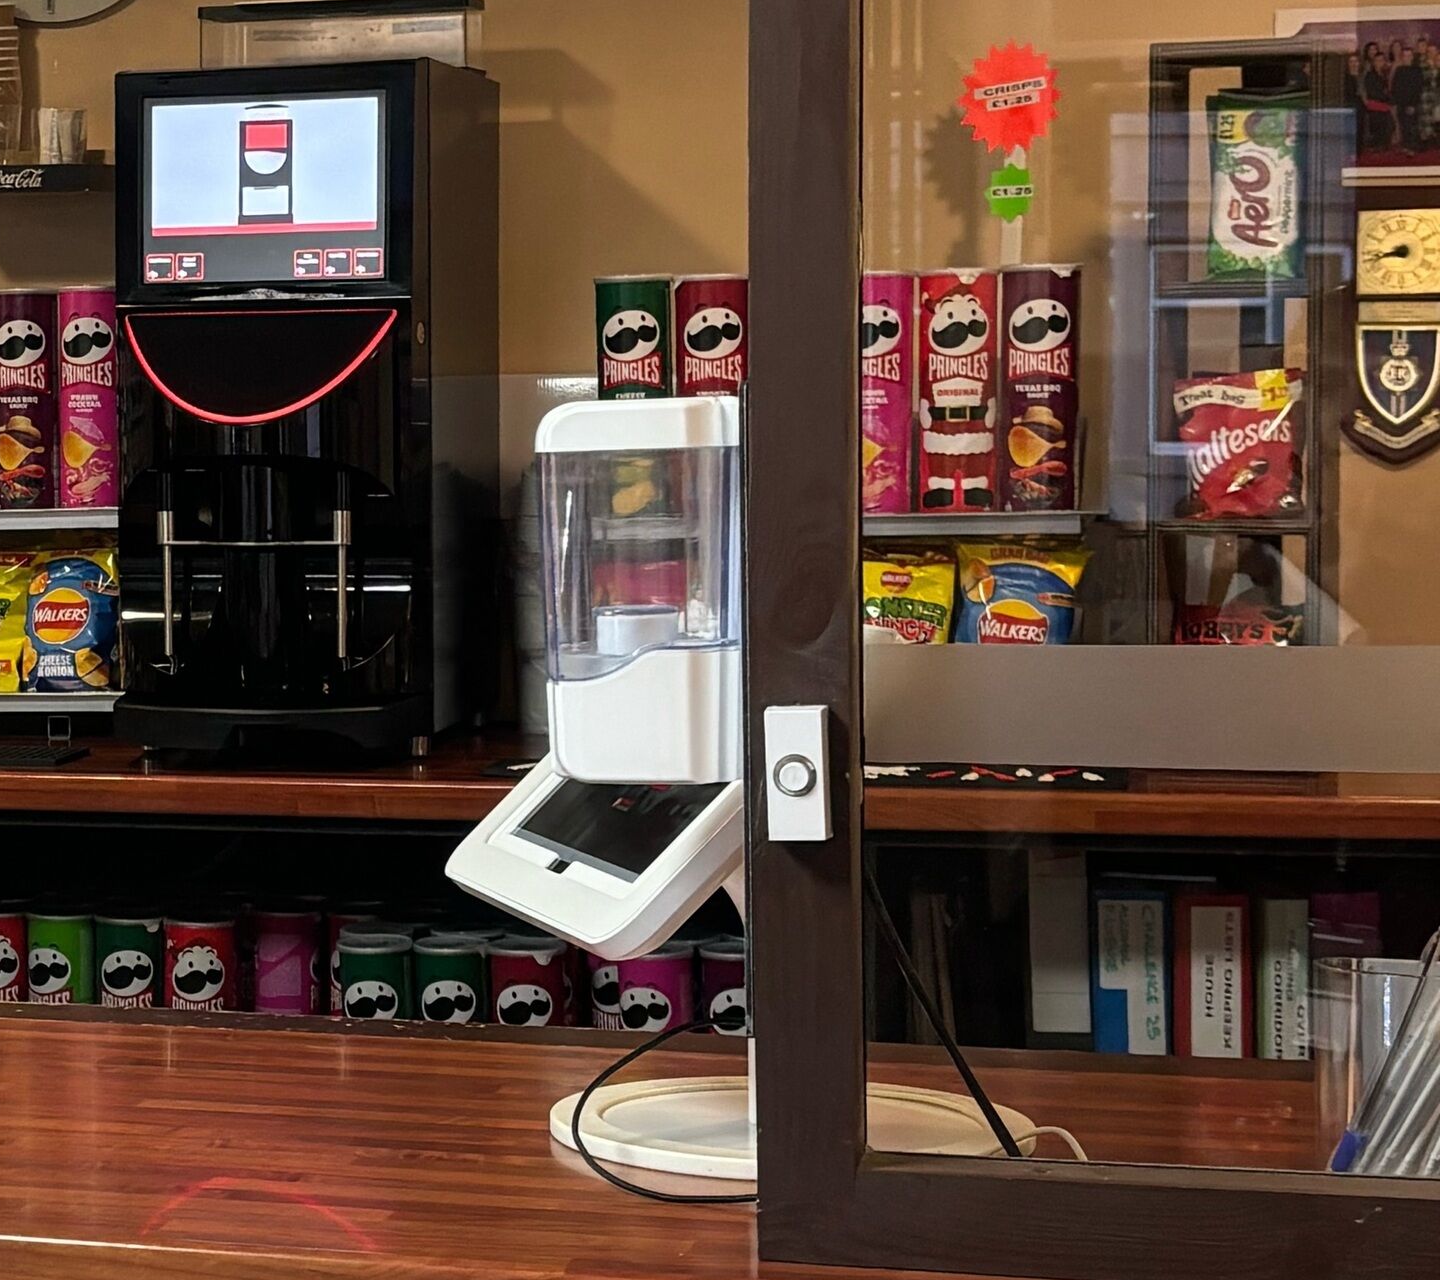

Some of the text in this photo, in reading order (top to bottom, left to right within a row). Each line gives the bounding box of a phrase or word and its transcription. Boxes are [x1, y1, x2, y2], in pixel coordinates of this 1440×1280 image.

[984, 80, 1043, 96] CRISPS
[1218, 113, 1237, 141] £1.25
[1229, 154, 1279, 248] Aero
[62, 362, 112, 387] PRINGLES
[603, 356, 660, 385] PRINGLES
[685, 354, 742, 383] PRINGLES
[929, 353, 988, 381] PRINGLES
[1009, 348, 1069, 377] PRINGLES
[35, 607, 87, 623] WALKERS
[980, 620, 1046, 643] WALKERS
[39, 655, 71, 666] CHEESE
[1205, 954, 1214, 1017] HOUSE
[1223, 969, 1234, 1049] KEEPING
